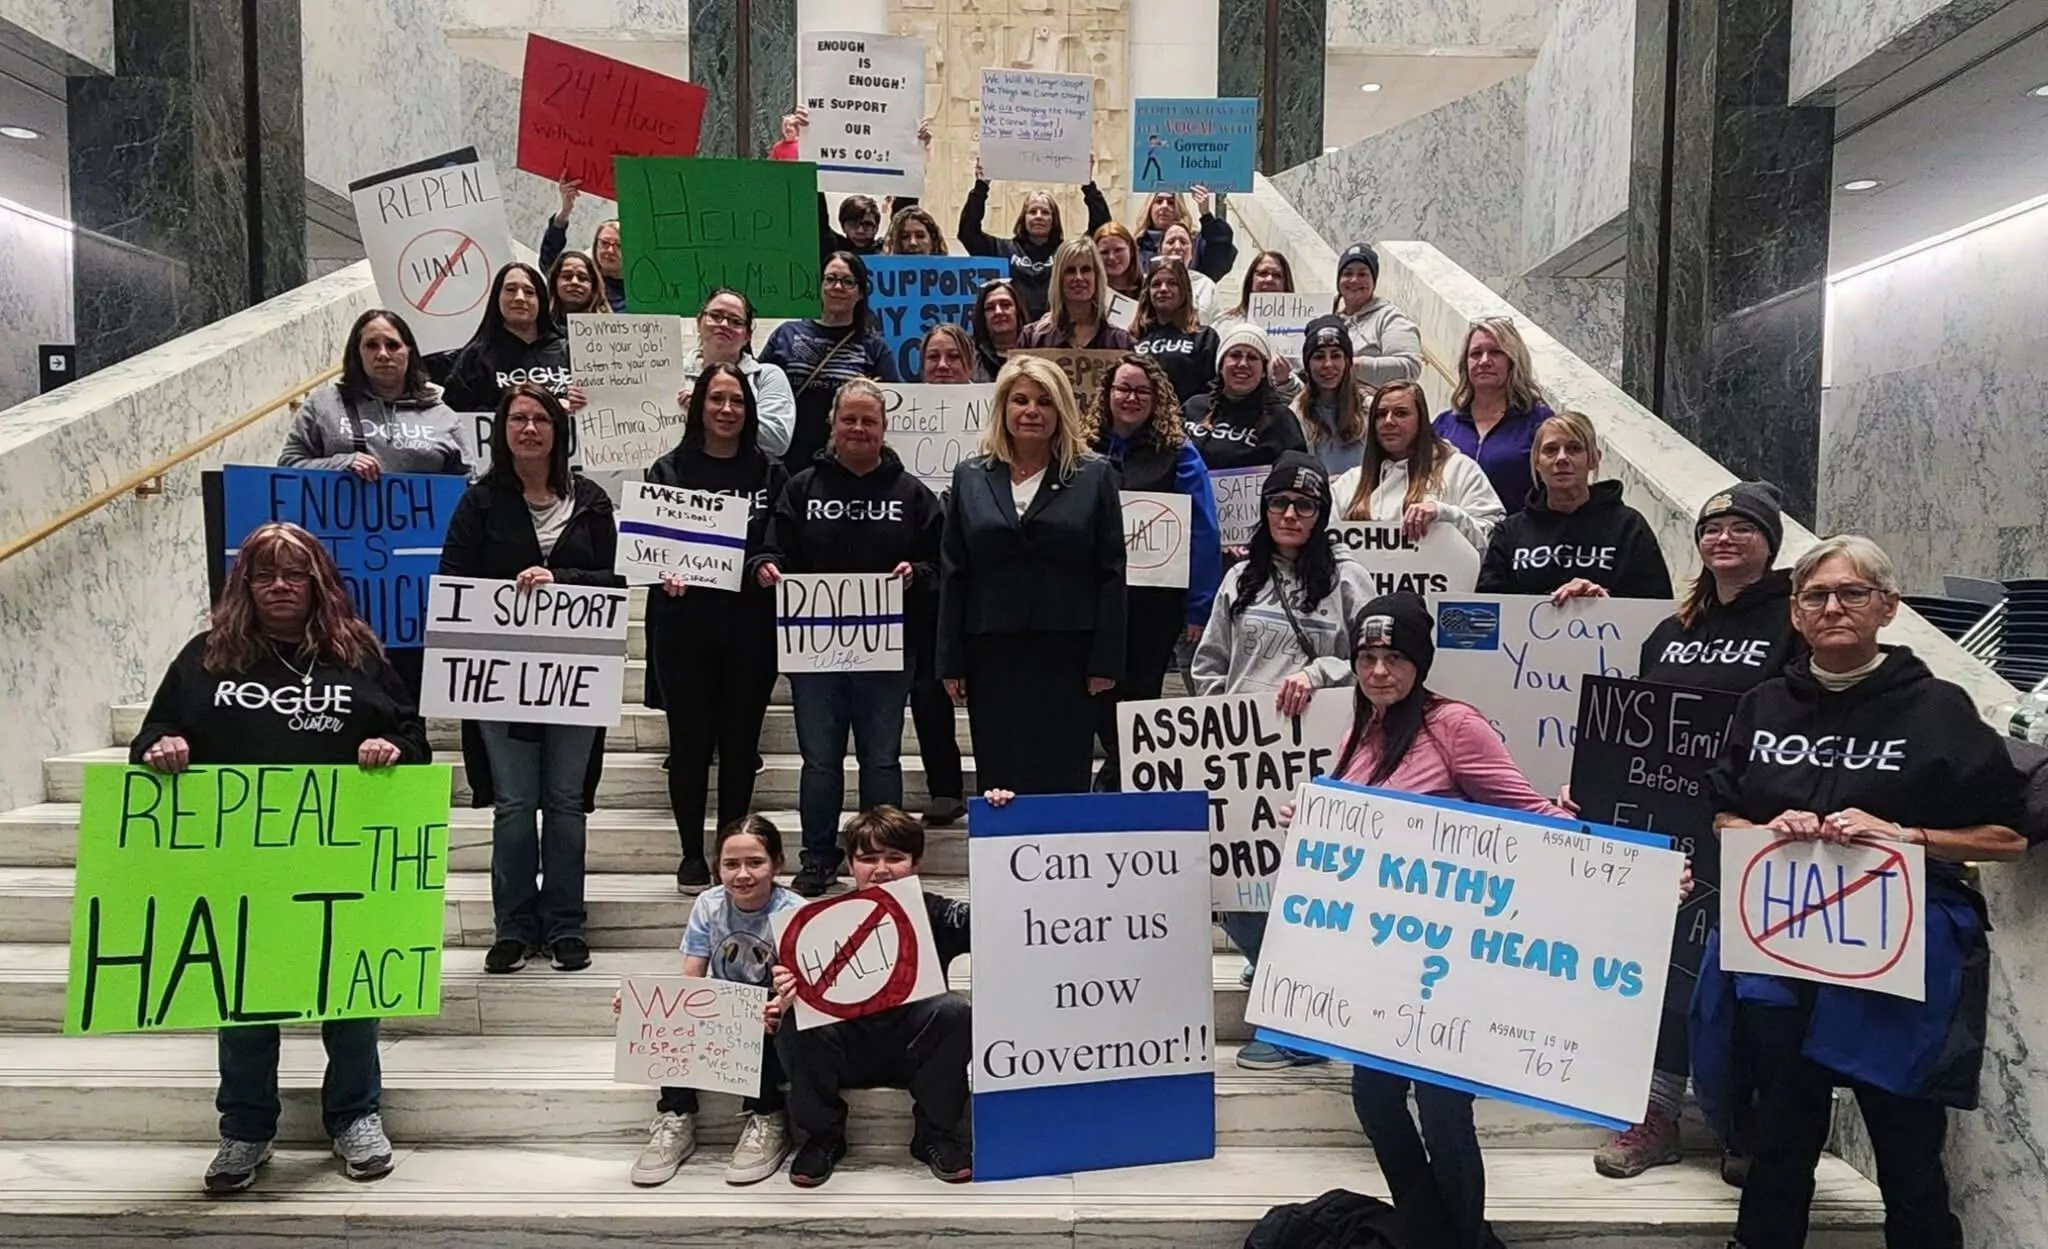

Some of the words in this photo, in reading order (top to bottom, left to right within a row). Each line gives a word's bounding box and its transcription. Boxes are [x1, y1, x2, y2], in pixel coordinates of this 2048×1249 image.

[817, 41, 865, 52] ENOUGH
[858, 58, 871, 68] IS
[849, 75, 906, 89] ENOUGH!
[808, 98, 825, 108] WE
[831, 98, 887, 113] SUPPORT
[845, 123, 871, 135] OUR
[1165, 119, 1214, 135] VOCAL
[820, 148, 847, 159] NYS
[1174, 138, 1230, 153] Governor
[1180, 156, 1222, 169] Hochul
[378, 167, 500, 224] REPEAL
[643, 168, 793, 243] HELP!
[411, 252, 469, 284] HALT
[1253, 295, 1285, 318] Hold
[1289, 295, 1316, 318] the
[586, 340, 602, 353] do
[609, 342, 631, 357] your
[1134, 339, 1194, 354] OGUE
[496, 365, 573, 388] ROGUE
[573, 357, 609, 373] Listen
[611, 361, 622, 370] to
[627, 359, 647, 373] your
[650, 358, 671, 368] own
[881, 389, 952, 432] Protect
[269, 472, 436, 533] ENOUGH
[640, 485, 686, 506] MAKE
[690, 494, 725, 512] NYS
[1216, 474, 1267, 503] SAFE
[656, 506, 717, 528] PRISONS
[807, 499, 903, 521] ROGUE
[1218, 504, 1260, 523] ORKIN
[626, 539, 671, 565] SAFE
[678, 553, 733, 572] AGAIN
[1326, 527, 1420, 552] OCHUL,
[1513, 544, 1616, 571] ROGUE
[1370, 573, 1448, 593] HATS
[436, 583, 475, 622] I
[493, 584, 627, 629] SUPPORT
[783, 577, 904, 654] ROGUE
[1529, 601, 1622, 641] Can
[808, 650, 873, 671] Wife
[1503, 642, 1572, 692] You
[1660, 640, 1770, 668] ROGUE
[214, 680, 352, 714] ROGUE
[442, 657, 511, 703] THE
[519, 662, 599, 707] LINE
[288, 711, 344, 733] Sister
[1585, 685, 1654, 748] NYS
[1669, 692, 1735, 759] Famil
[1748, 730, 1906, 772] ROGUE
[1132, 758, 1183, 791] ON
[1204, 748, 1332, 791] STAFF
[1628, 757, 1699, 797] Before
[119, 767, 361, 850] REPEAL
[361, 823, 447, 892] THE
[1299, 788, 1384, 841] Inmate
[1407, 815, 1424, 831] on
[1433, 811, 1519, 863] Inmate
[1542, 830, 1592, 852] ASSAULT
[1601, 841, 1614, 855] IS
[1009, 841, 1093, 883] Can
[1105, 845, 1180, 888] you
[1211, 839, 1281, 878] ORD
[1296, 838, 1366, 881] HEY
[1379, 853, 1520, 921] KATHY,
[1760, 860, 1898, 951] HALT
[1025, 907, 1113, 947] hear
[1127, 911, 1169, 941] us
[1282, 893, 1354, 932] CAN
[1370, 911, 1453, 949] YOU
[1471, 928, 1578, 981] HEAR
[1592, 956, 1644, 996] US
[347, 946, 436, 1010] ACT
[1054, 976, 1141, 1010] now
[1420, 955, 1450, 1000] ?
[628, 979, 720, 1018] We
[1260, 963, 1351, 1029] Inmate
[1372, 1008, 1385, 1019] on
[1397, 1003, 1471, 1055] Staff
[1489, 1022, 1536, 1042] ASSAULT
[1544, 1035, 1556, 1047] IS
[641, 1023, 697, 1040] need
[705, 1041, 729, 1057] for
[983, 1025, 1208, 1081] Governor!!
[714, 1071, 748, 1086] Them
